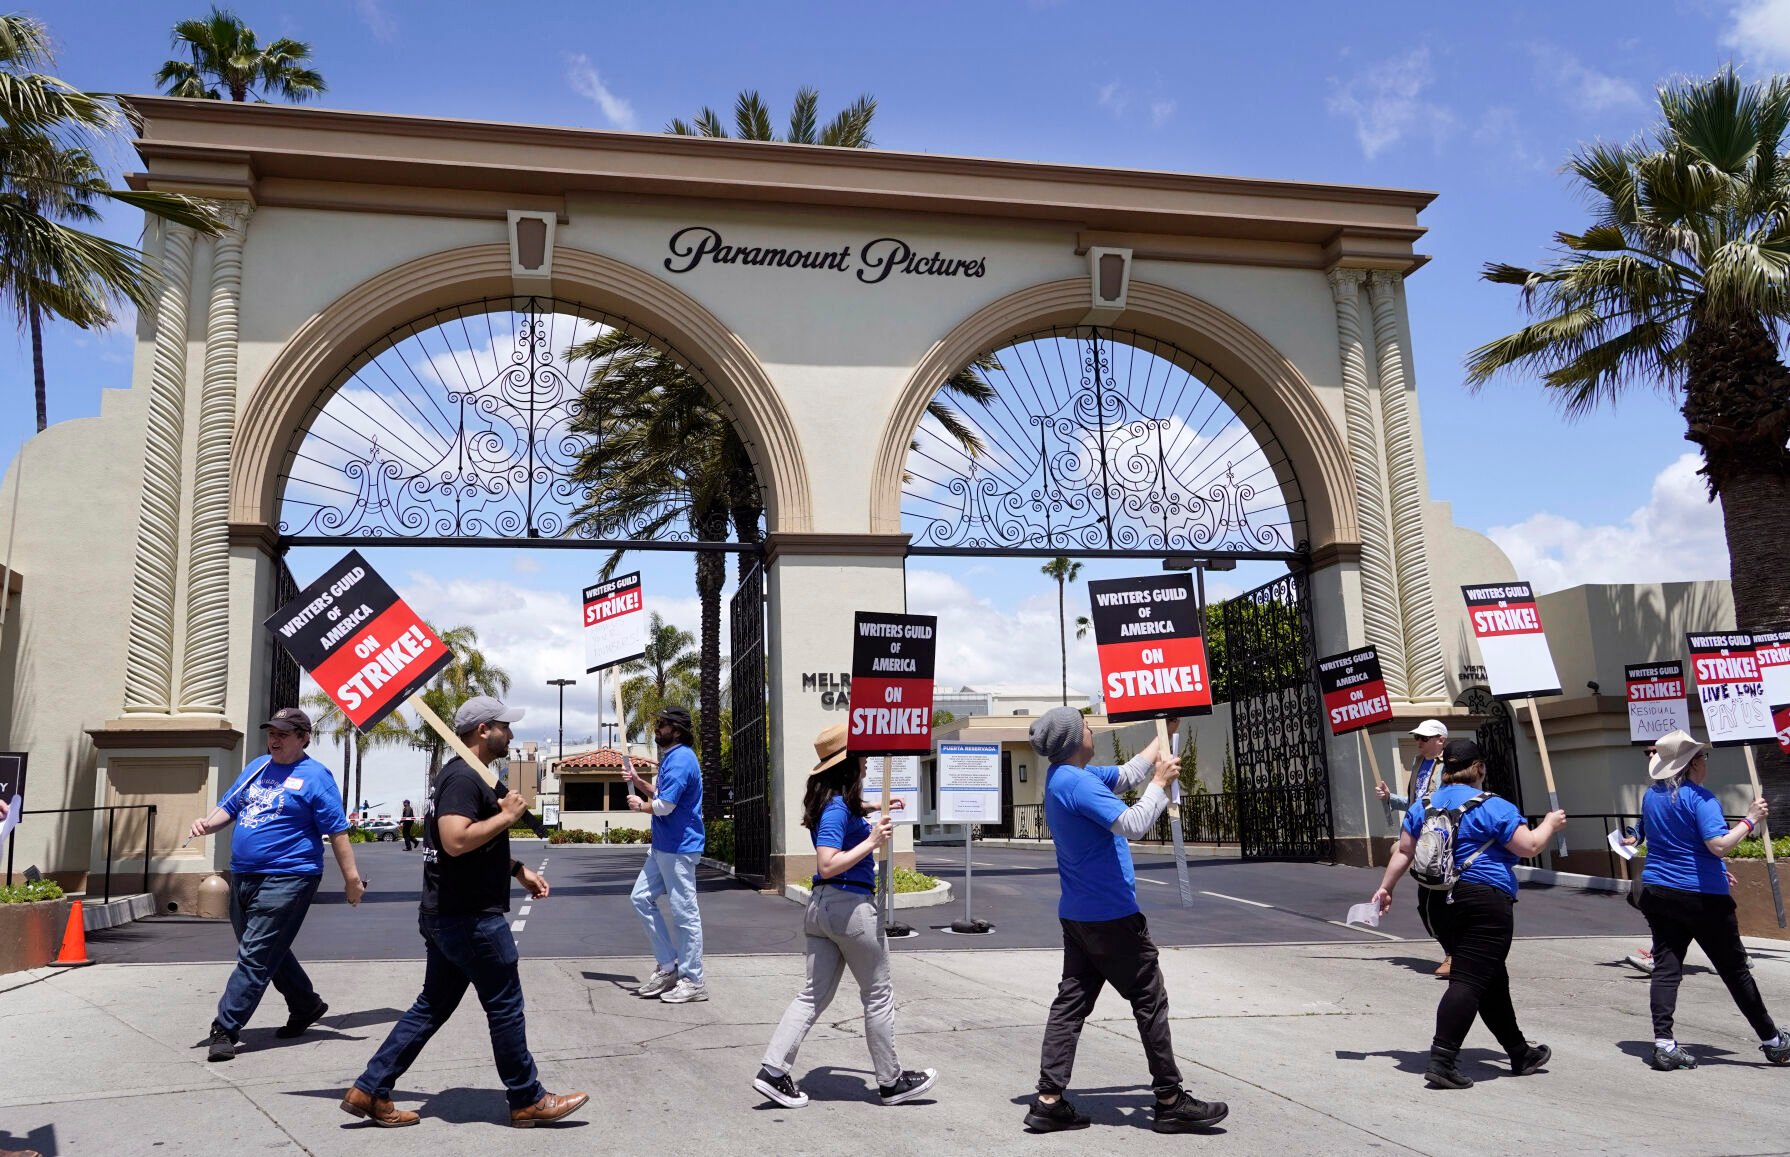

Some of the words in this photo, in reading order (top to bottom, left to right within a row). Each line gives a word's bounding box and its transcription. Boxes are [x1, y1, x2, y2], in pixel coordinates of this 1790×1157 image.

[664, 227, 850, 273] Paramount
[856, 237, 985, 283] Pictures
[586, 582, 616, 599] WRITERS
[617, 575, 637, 588] GUILD
[1466, 587, 1505, 600] WRITERS
[1506, 586, 1529, 598] GUILD
[280, 592, 334, 638] WRITERS
[330, 566, 365, 597] GUILD
[1096, 590, 1152, 606] WRITERS
[1152, 588, 1187, 602] GUILD
[327, 606, 342, 620] OF
[587, 592, 639, 623] STRIKE!
[1138, 607, 1151, 618] OF
[320, 604, 374, 650] AMERICA
[1120, 620, 1175, 637] AMERICA
[1474, 608, 1538, 632] STRIKE!
[859, 622, 903, 638] WRITERS
[905, 625, 932, 639] GUILD
[354, 635, 380, 659] ON
[890, 642, 901, 654] OF
[1690, 636, 1728, 647] WRITERS
[1728, 635, 1751, 646] GUILD
[872, 658, 916, 672] AMERICA
[1142, 648, 1164, 664] ON
[1320, 657, 1352, 672] WRITERS
[1353, 651, 1374, 663] GUILD
[337, 624, 432, 710] STRIKE!
[1628, 668, 1658, 678] WRITERS
[1659, 666, 1679, 675] GUILD
[1696, 657, 1759, 680] STRIKE!
[802, 672, 850, 688] MELR
[1107, 664, 1203, 698] STRIKE!
[1336, 672, 1368, 687] AMERICA
[821, 691, 850, 706] GA
[885, 686, 902, 702] ON
[1350, 690, 1364, 700] ON
[1630, 681, 1682, 700] STRIKE!
[1702, 683, 1730, 703] LIVE
[1735, 683, 1764, 697] LONG
[1331, 695, 1388, 724] STRIKE!
[1707, 702, 1738, 731] PAY
[1741, 698, 1764, 724] US
[852, 707, 929, 735] STRIKE!
[1638, 718, 1678, 734] ANGER
